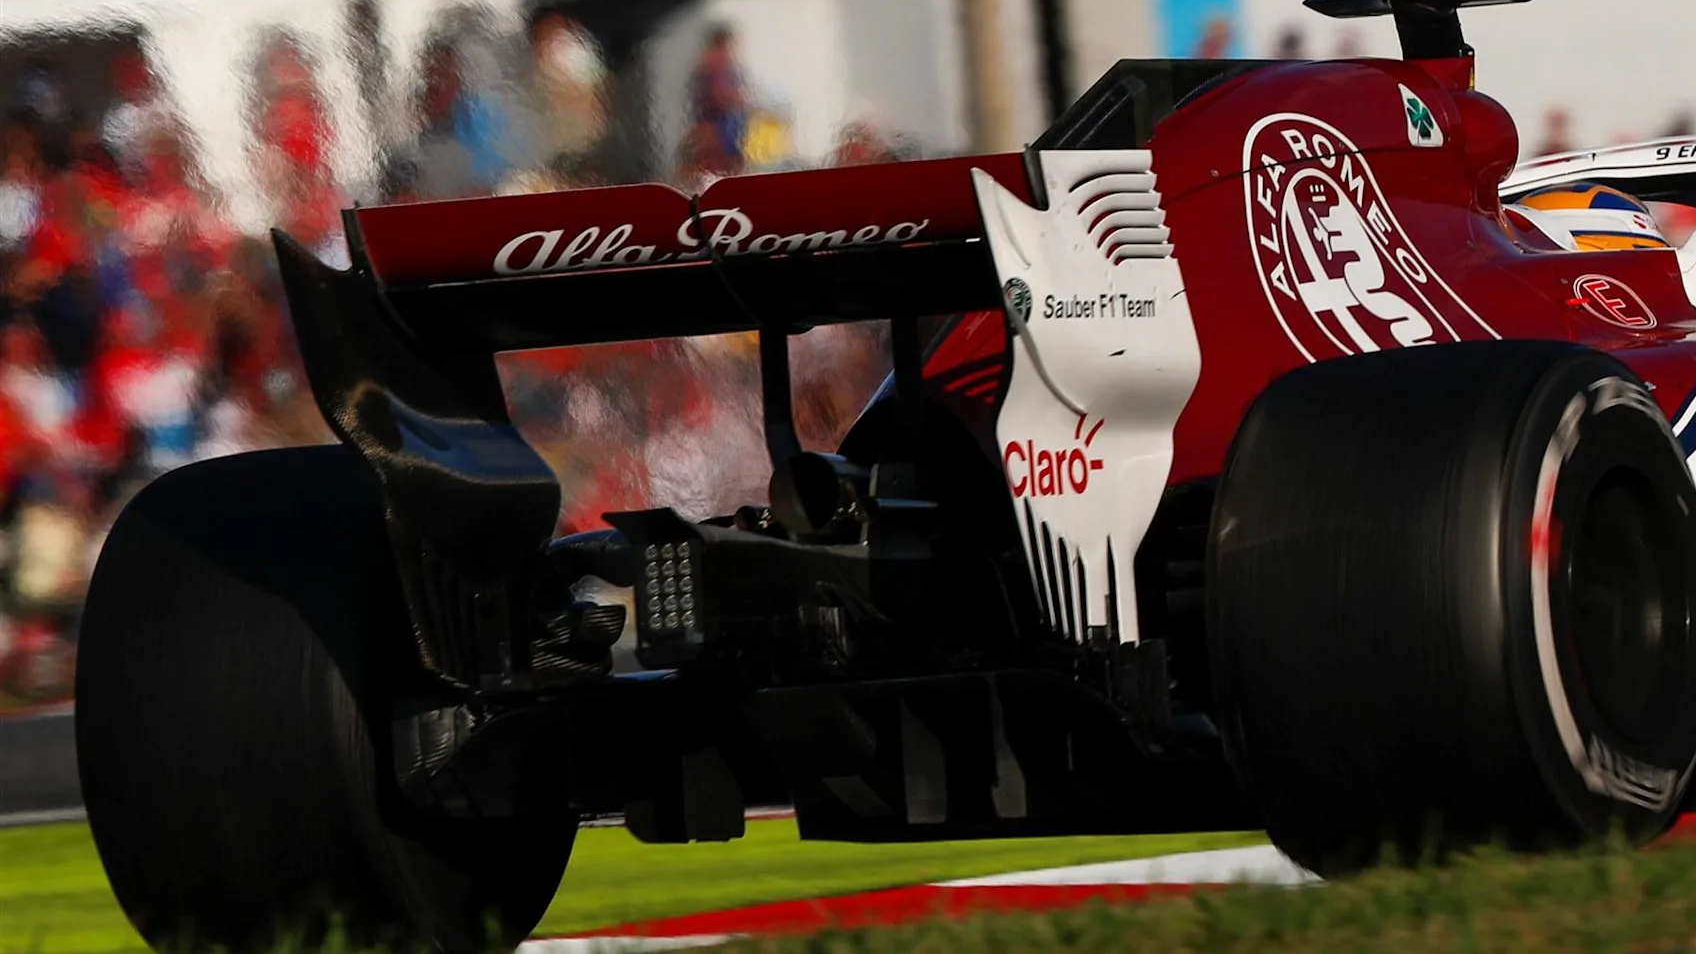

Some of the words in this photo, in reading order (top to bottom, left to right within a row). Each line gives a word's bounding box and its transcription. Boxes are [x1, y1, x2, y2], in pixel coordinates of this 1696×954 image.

[1656, 147, 1671, 161] 9
[493, 223, 673, 276] Alfa
[676, 207, 930, 259] Romeo
[1257, 153, 1298, 301] ALFA
[1281, 129, 1428, 285] ROMEO
[1043, 294, 1095, 319] Sauber
[1100, 294, 1116, 318] F1
[1119, 293, 1156, 318] Team
[1005, 439, 1088, 498] Claro
